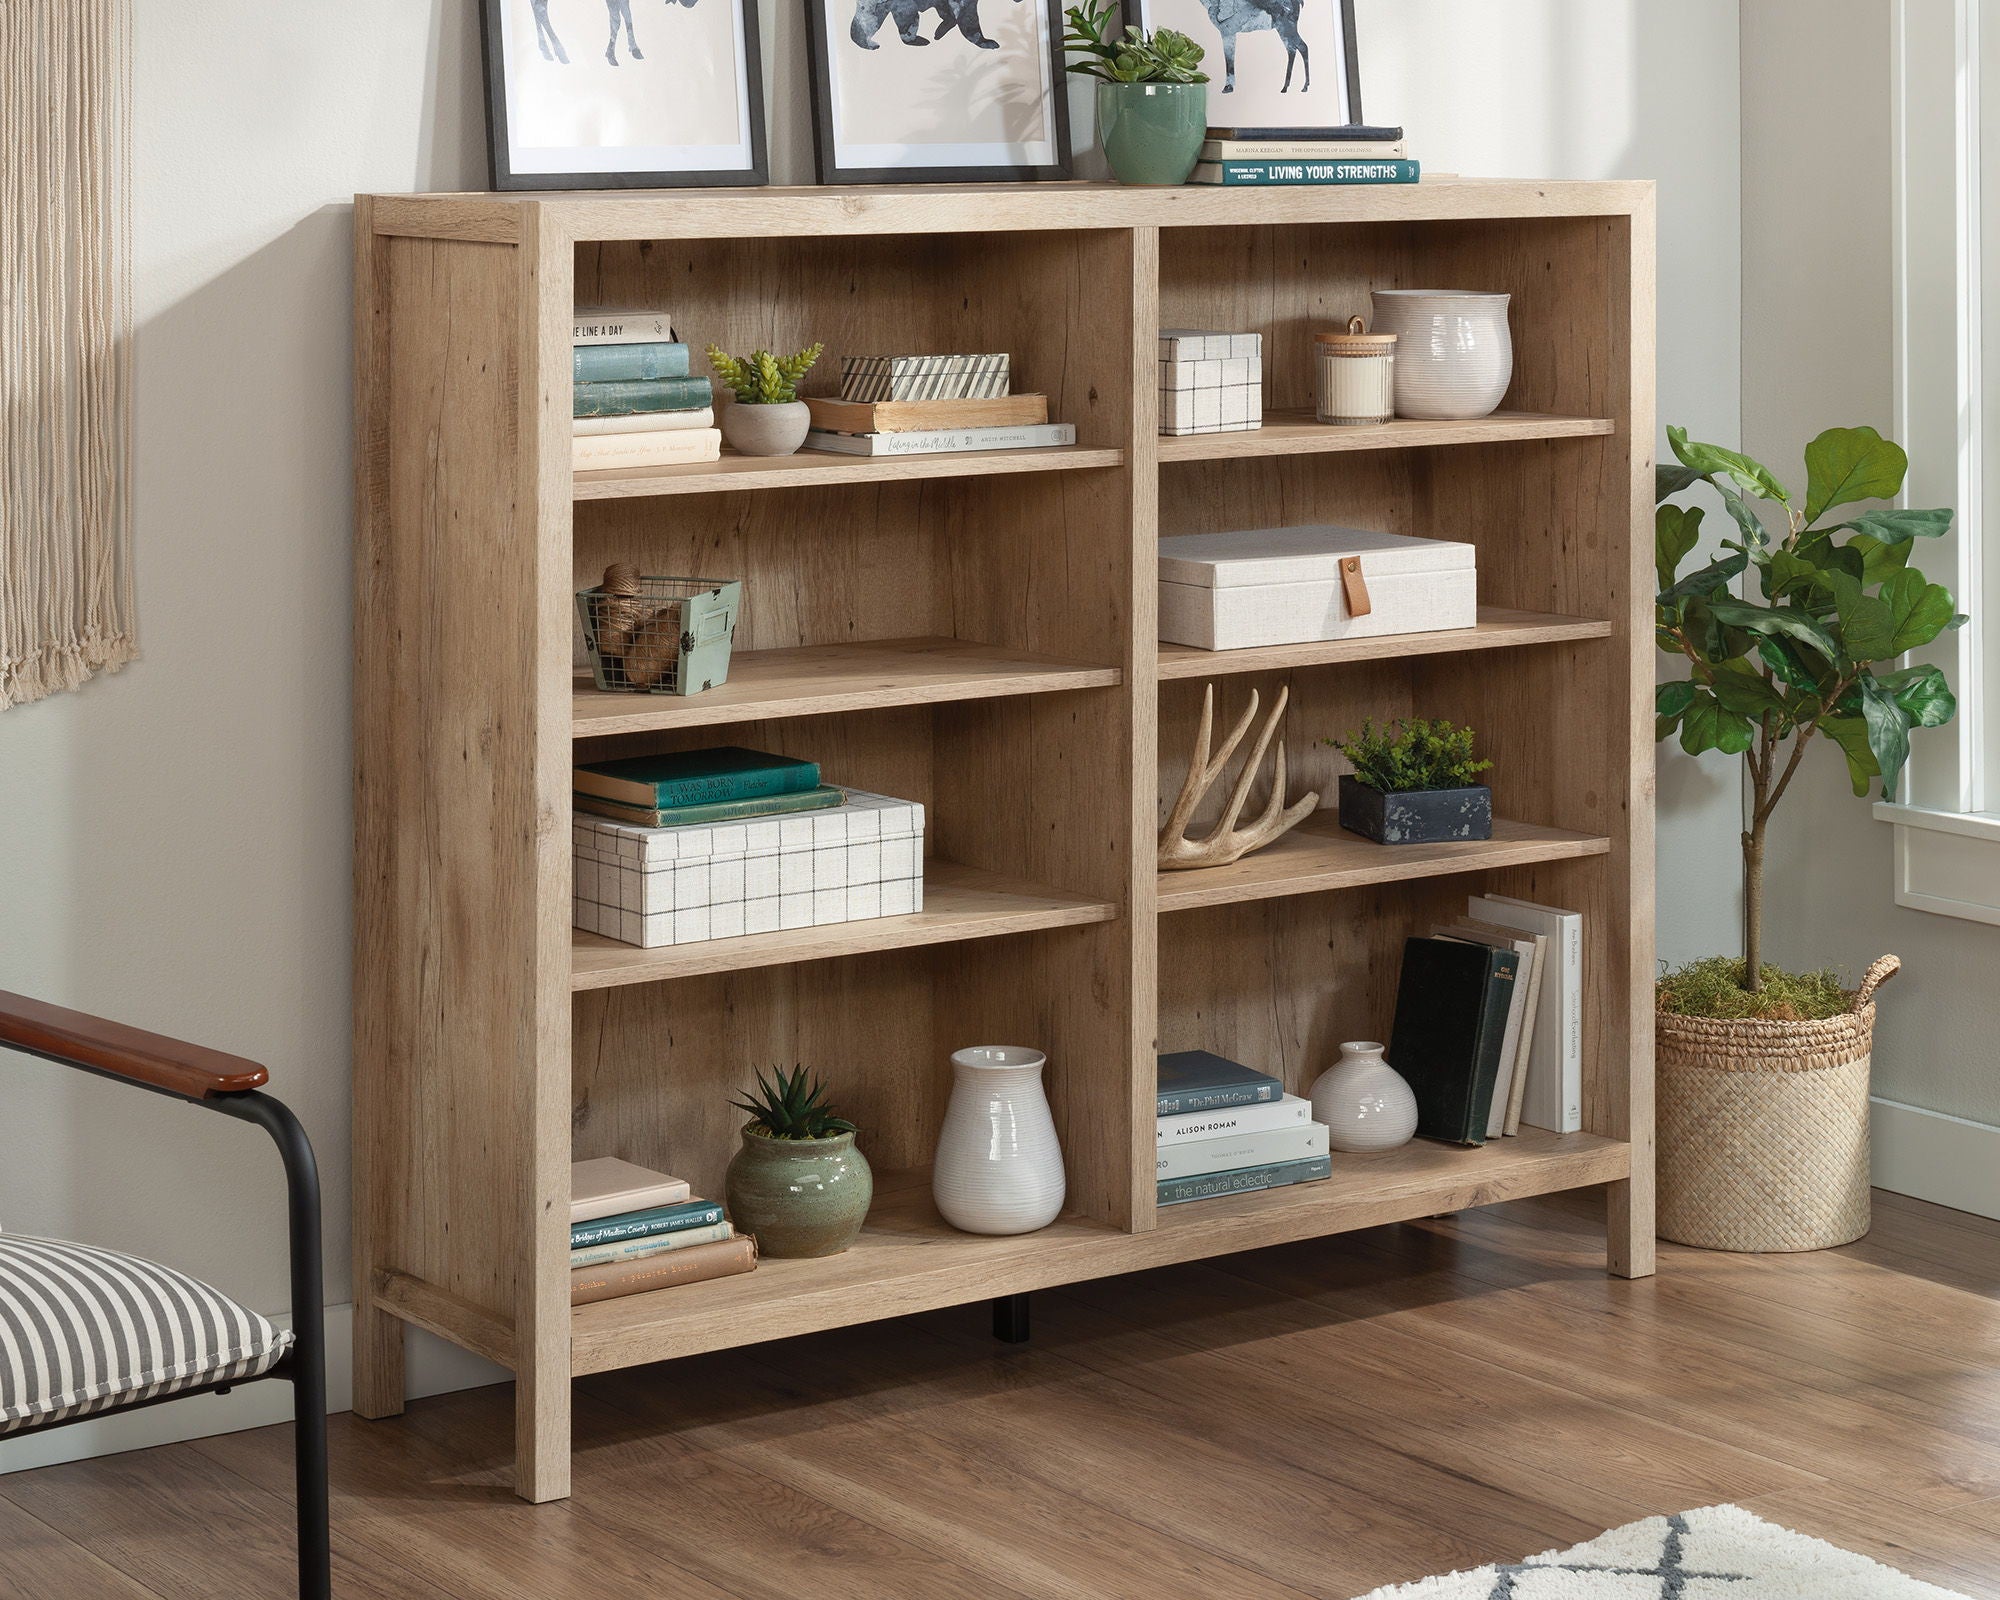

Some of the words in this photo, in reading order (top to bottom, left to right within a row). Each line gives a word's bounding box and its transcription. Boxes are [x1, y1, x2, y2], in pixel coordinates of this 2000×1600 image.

[1268, 166, 1303, 180] LIVING
[1305, 165, 1334, 179] YOUR
[1336, 164, 1397, 179] STRENGTHS
[582, 326, 598, 337] LINE
[601, 325, 606, 336] A
[608, 325, 624, 336] DAY
[678, 781, 702, 793] WAS
[707, 778, 735, 790] BORN
[670, 788, 734, 805] TOMORROW
[1176, 1124, 1206, 1136] ALISON
[1207, 1120, 1237, 1131] ROMAN
[1175, 1184, 1193, 1199] the
[1195, 1179, 1231, 1195] natural
[1233, 1171, 1273, 1188] eclectic
[575, 1232, 597, 1244] Bridges
[596, 1230, 603, 1242] of
[603, 1227, 627, 1238] Madison
[627, 1224, 649, 1235] County
